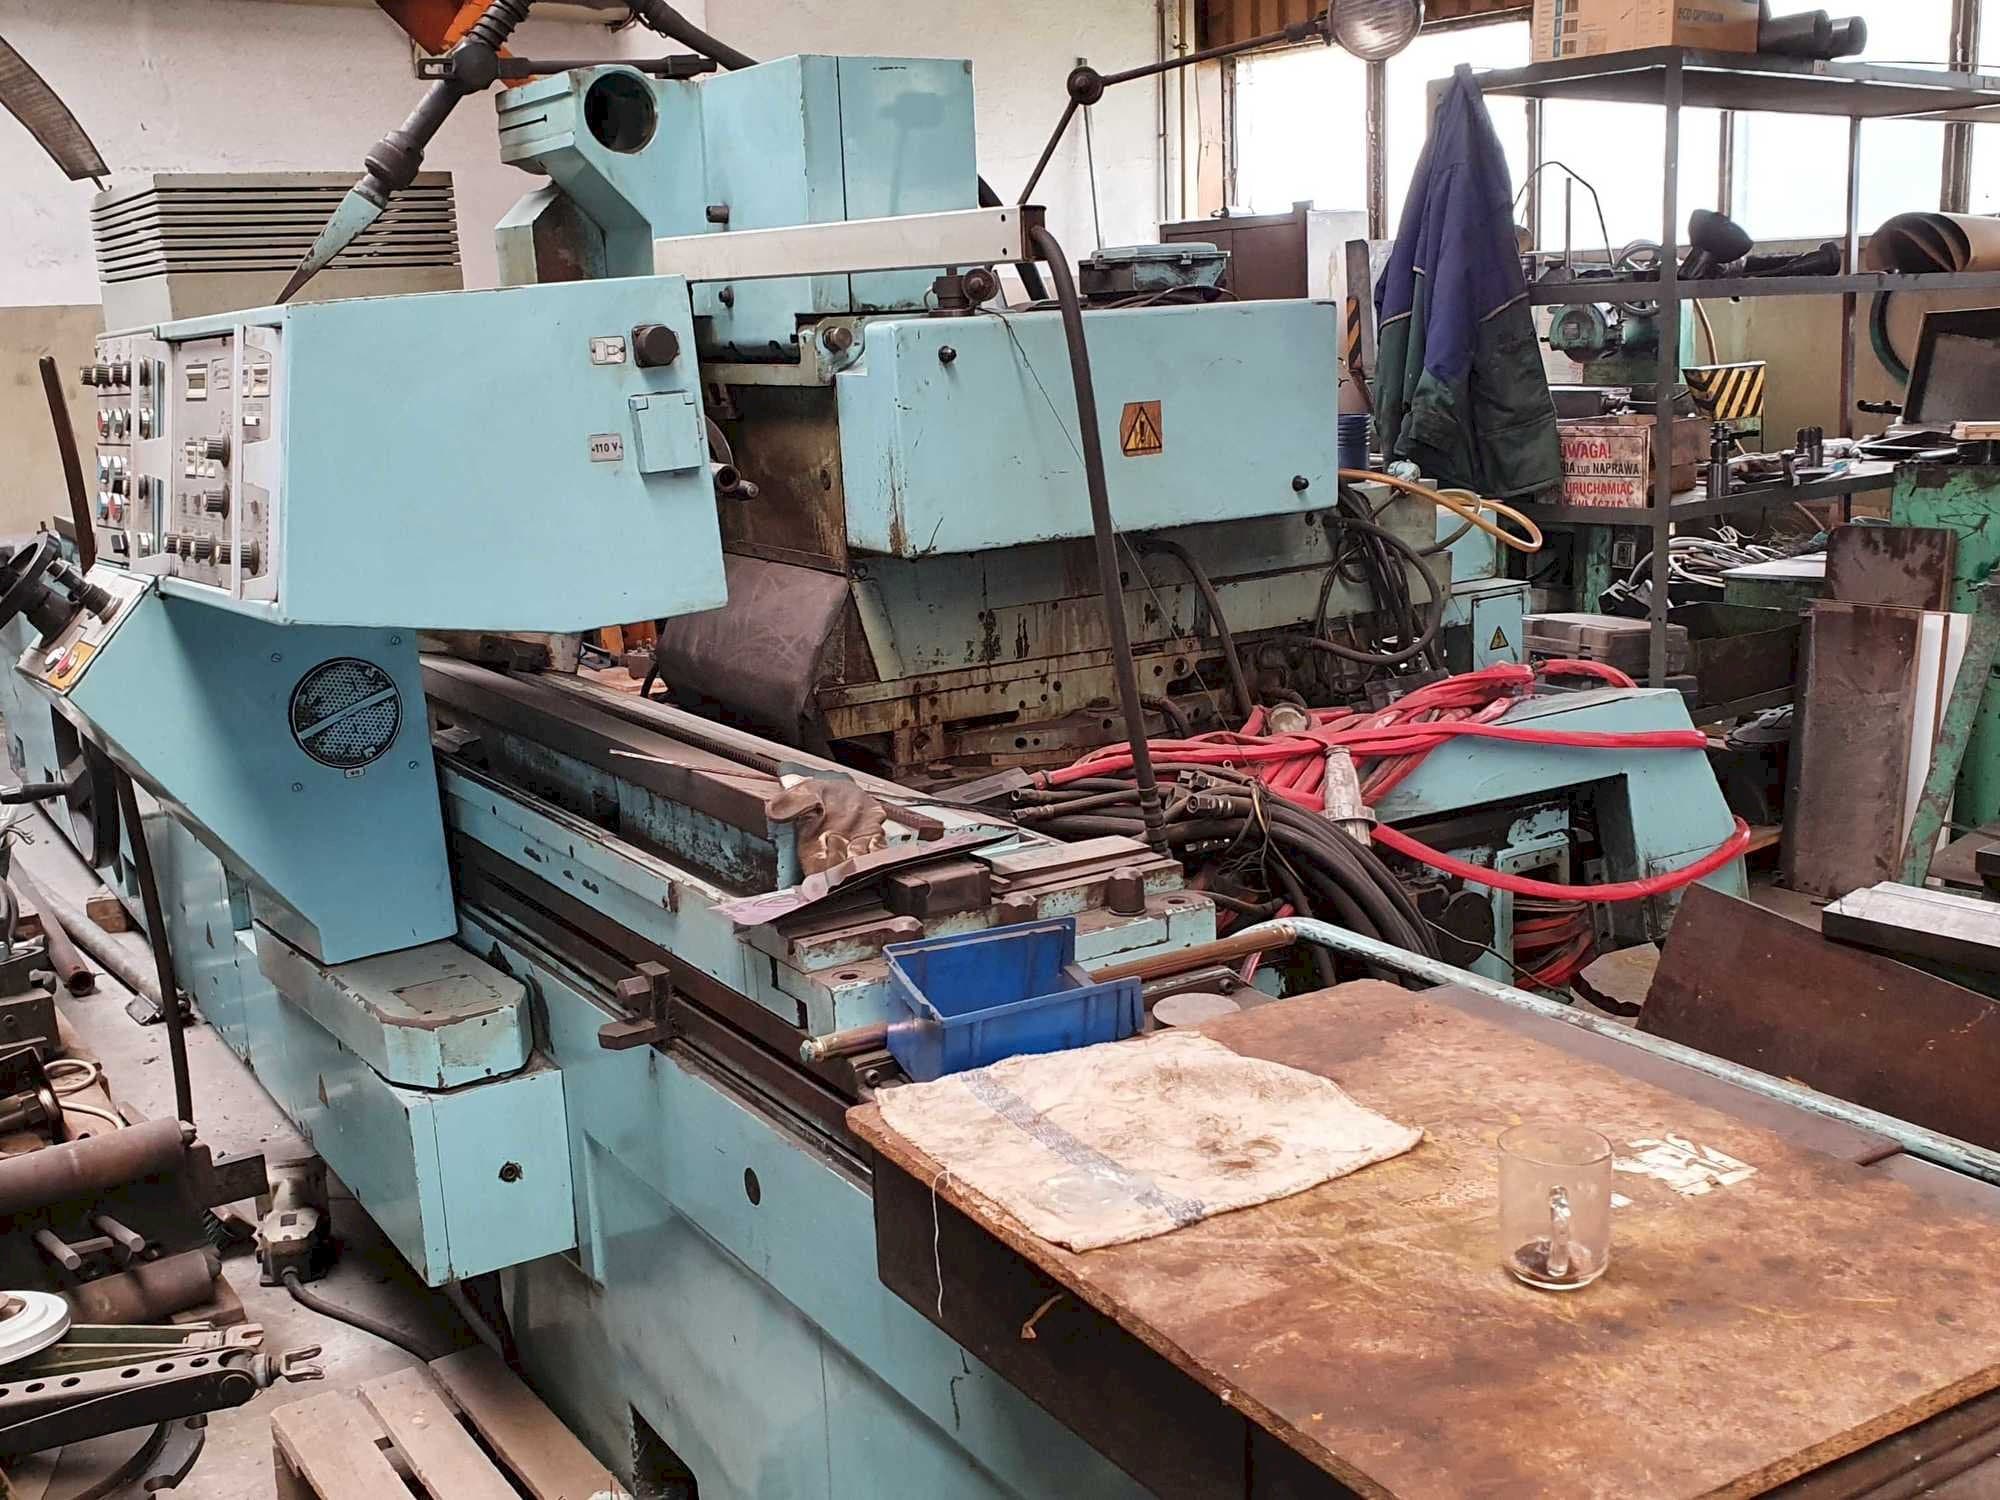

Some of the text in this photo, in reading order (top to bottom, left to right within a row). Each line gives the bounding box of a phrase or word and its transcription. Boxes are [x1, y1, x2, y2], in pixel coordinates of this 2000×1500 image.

[595, 442, 618, 453] 110 V
[1577, 465, 1591, 474] LUB
[1593, 463, 1640, 475] NAPRAWA
